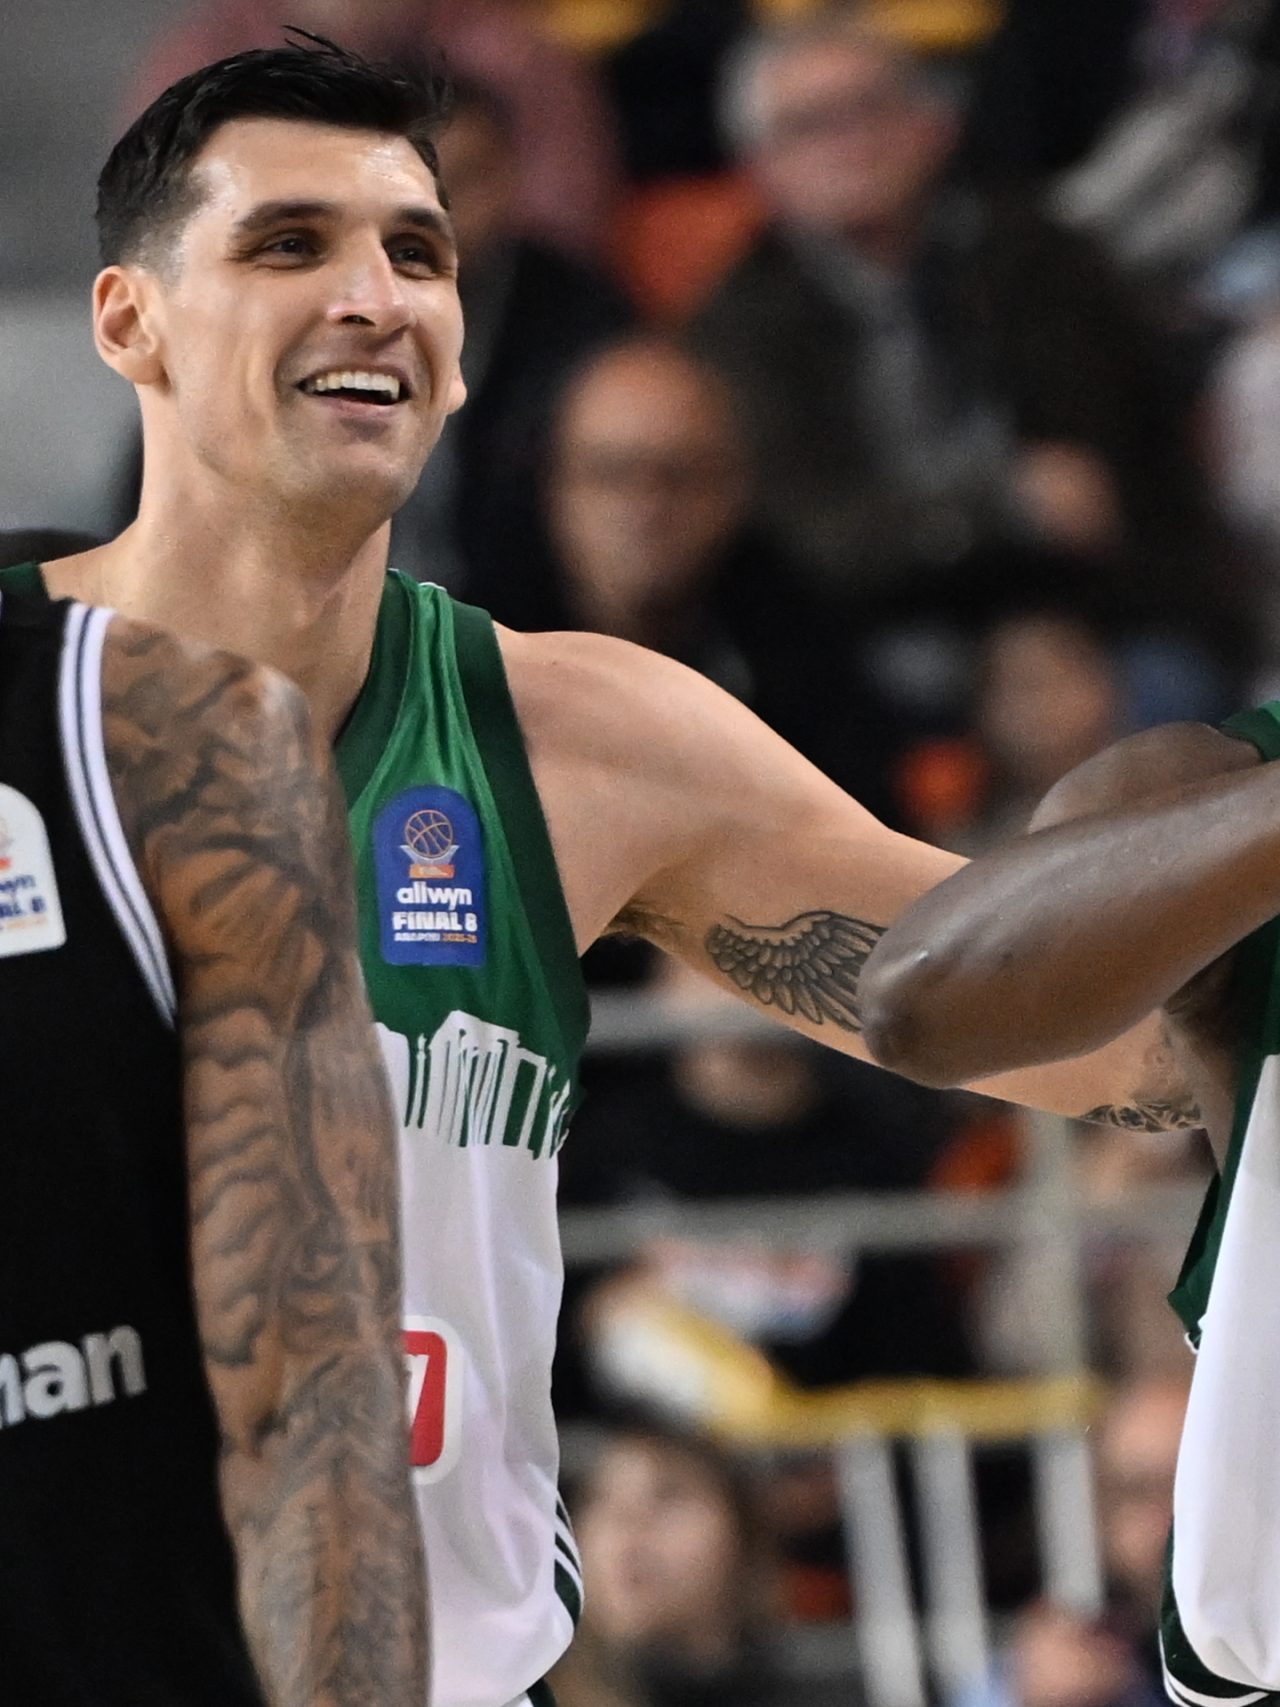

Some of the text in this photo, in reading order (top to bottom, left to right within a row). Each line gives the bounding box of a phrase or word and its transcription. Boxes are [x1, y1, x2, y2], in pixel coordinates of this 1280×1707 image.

[396, 881, 473, 911] allwyn
[392, 911, 478, 932] FINAL 8
